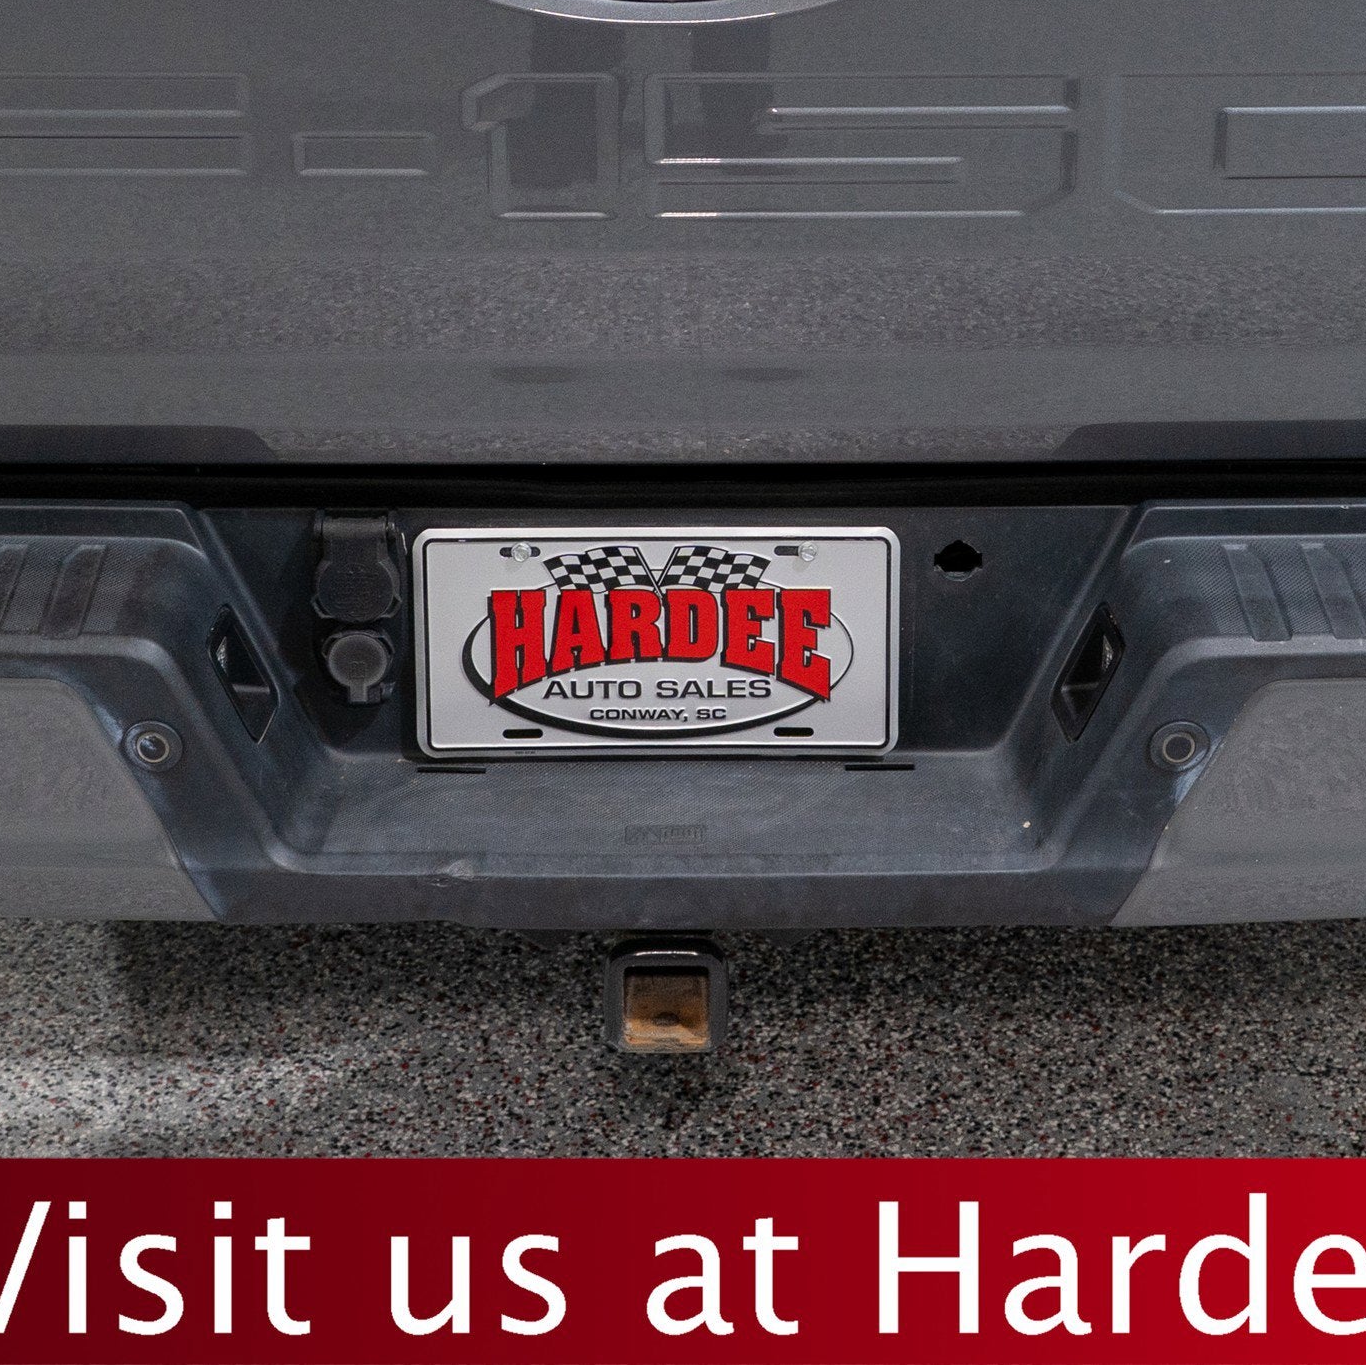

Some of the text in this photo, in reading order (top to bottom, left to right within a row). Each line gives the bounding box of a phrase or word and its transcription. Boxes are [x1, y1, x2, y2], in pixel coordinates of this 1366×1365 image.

[488, 588, 832, 702] HARDEE
[542, 679, 772, 699] AUTO SALES
[589, 708, 727, 722] CONWAY, SC
